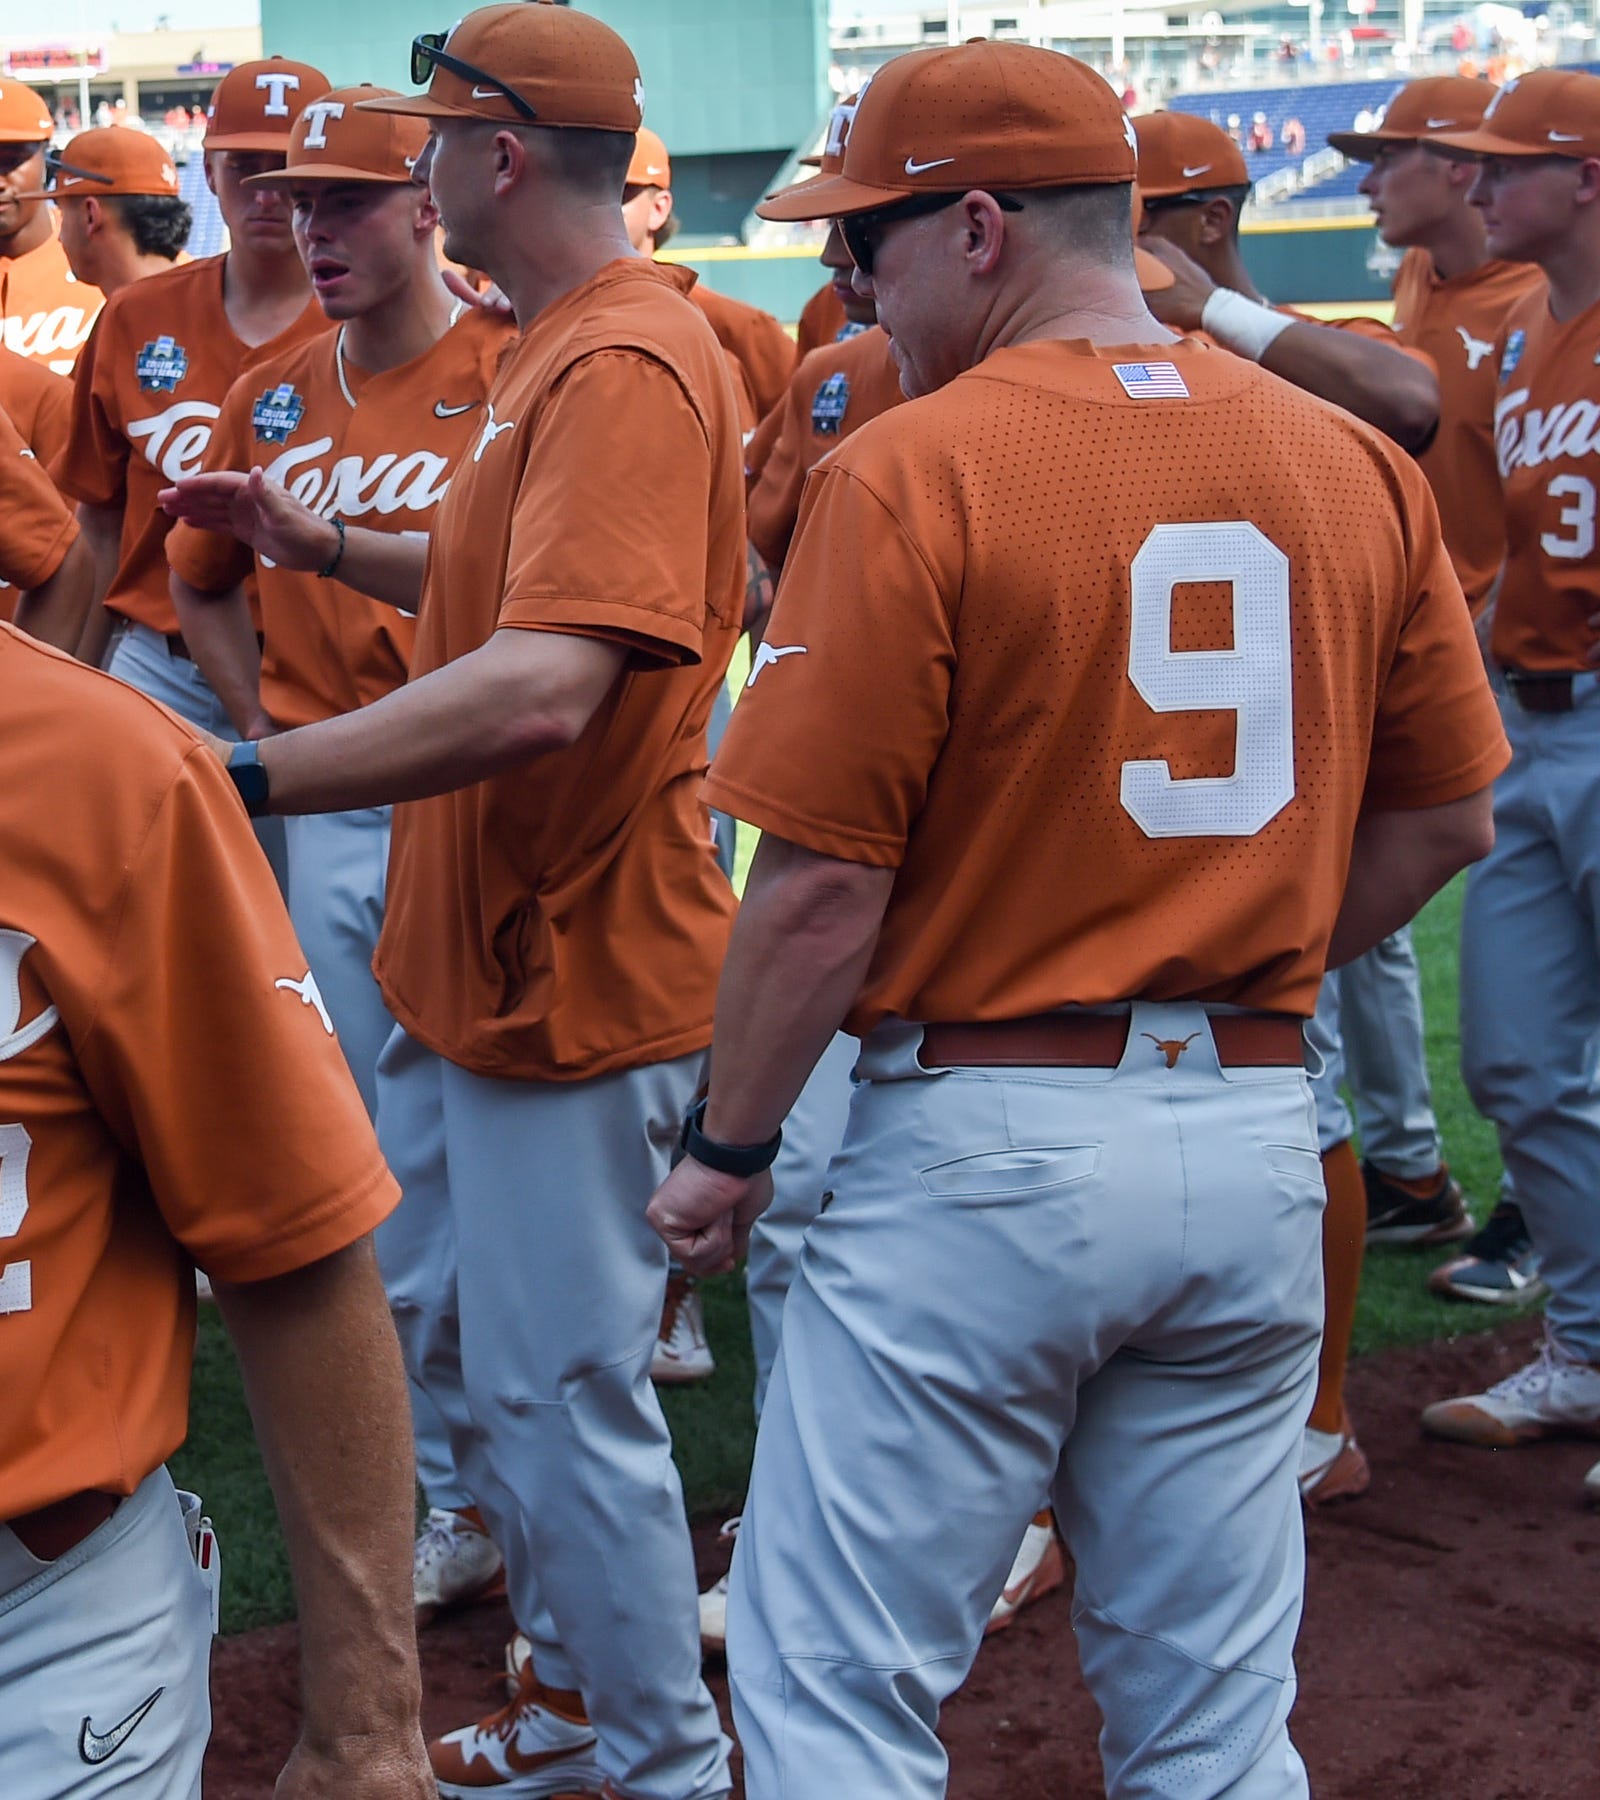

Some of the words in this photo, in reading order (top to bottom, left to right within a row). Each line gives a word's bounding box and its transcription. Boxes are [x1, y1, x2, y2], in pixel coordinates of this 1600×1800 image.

[256, 73, 299, 116] T
[302, 101, 346, 149] T
[263, 436, 452, 520] Texa
[1540, 474, 1597, 559] 3
[1120, 520, 1296, 838] 9
